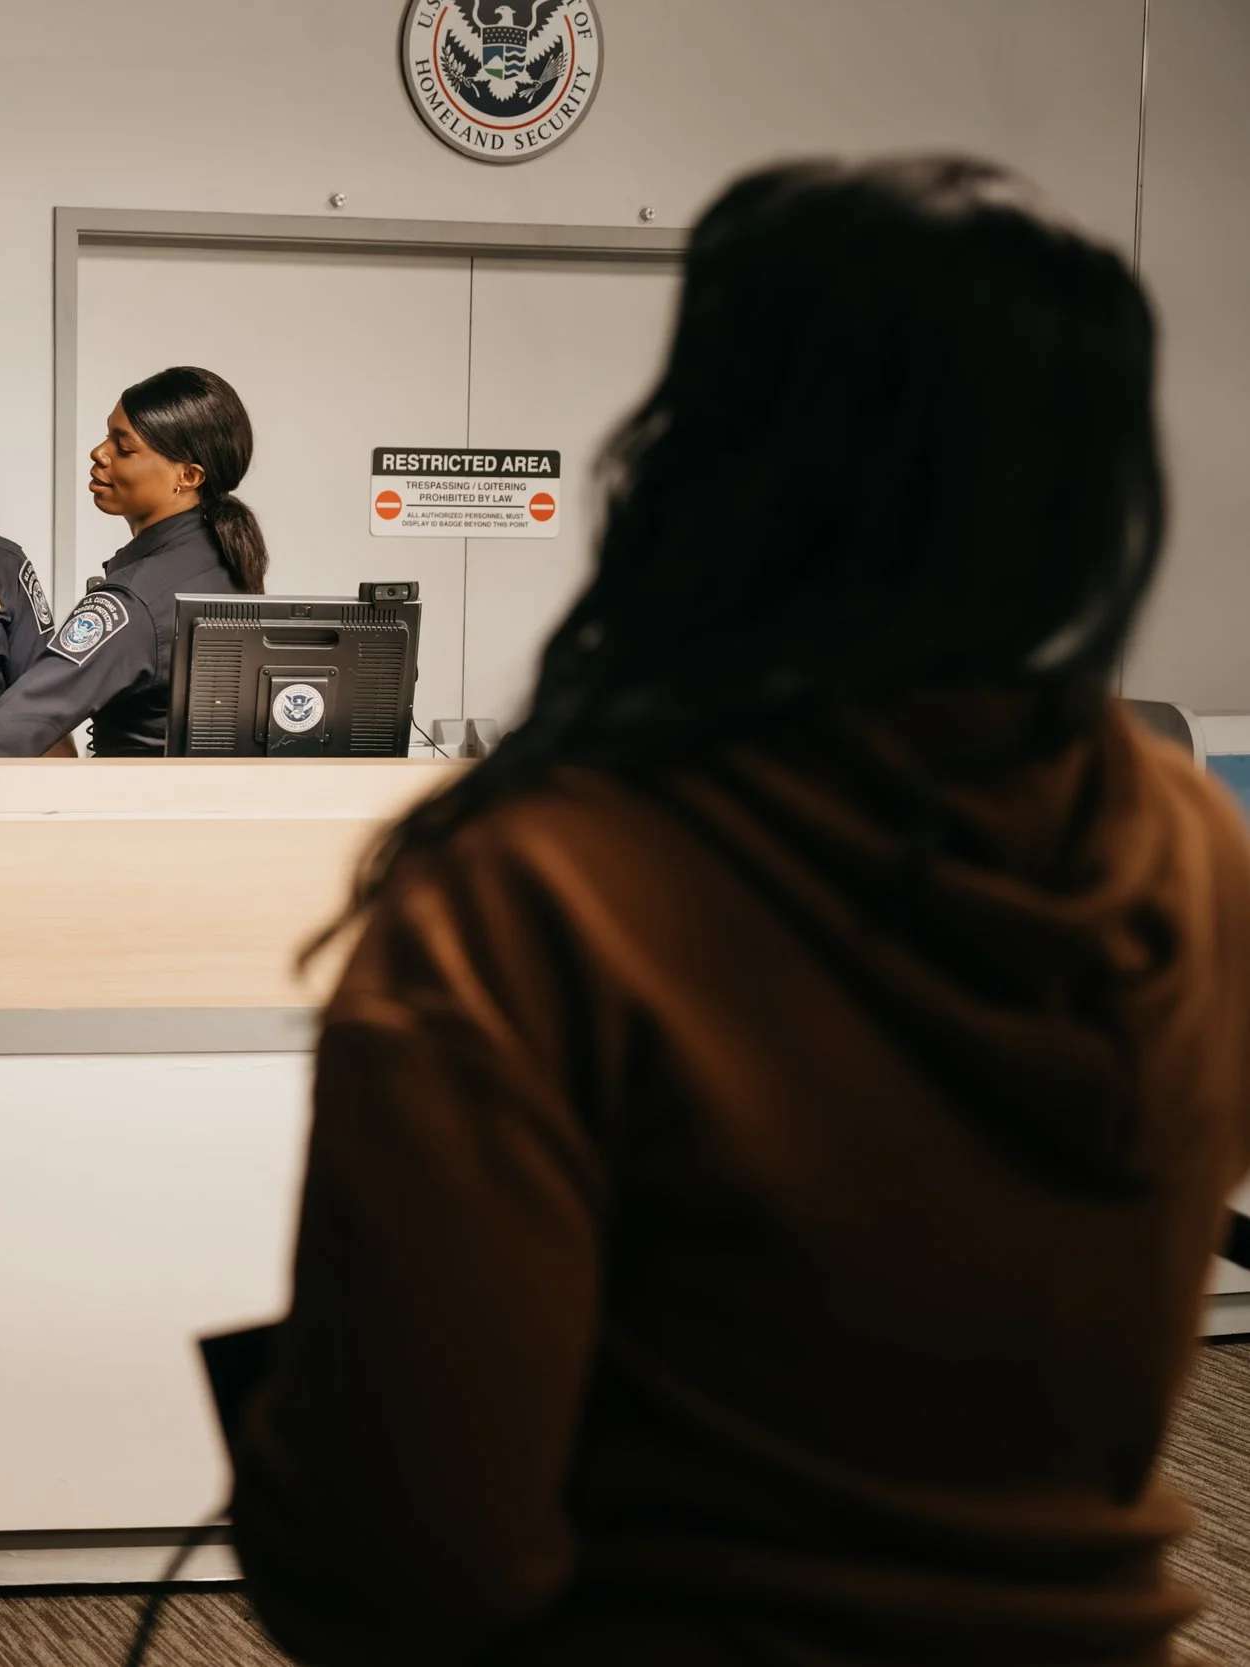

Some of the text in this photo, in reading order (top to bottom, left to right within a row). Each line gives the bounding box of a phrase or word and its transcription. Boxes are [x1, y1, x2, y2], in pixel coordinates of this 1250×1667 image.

[573, 12, 594, 40] OF
[415, 58, 592, 151] HOMELAND SECURITY
[382, 454, 552, 473] RESTRICTED AREA
[406, 481, 470, 490] TRESPASSING
[478, 482, 527, 491] LOITERING
[419, 494, 513, 503] PROHIBITED BY LAW
